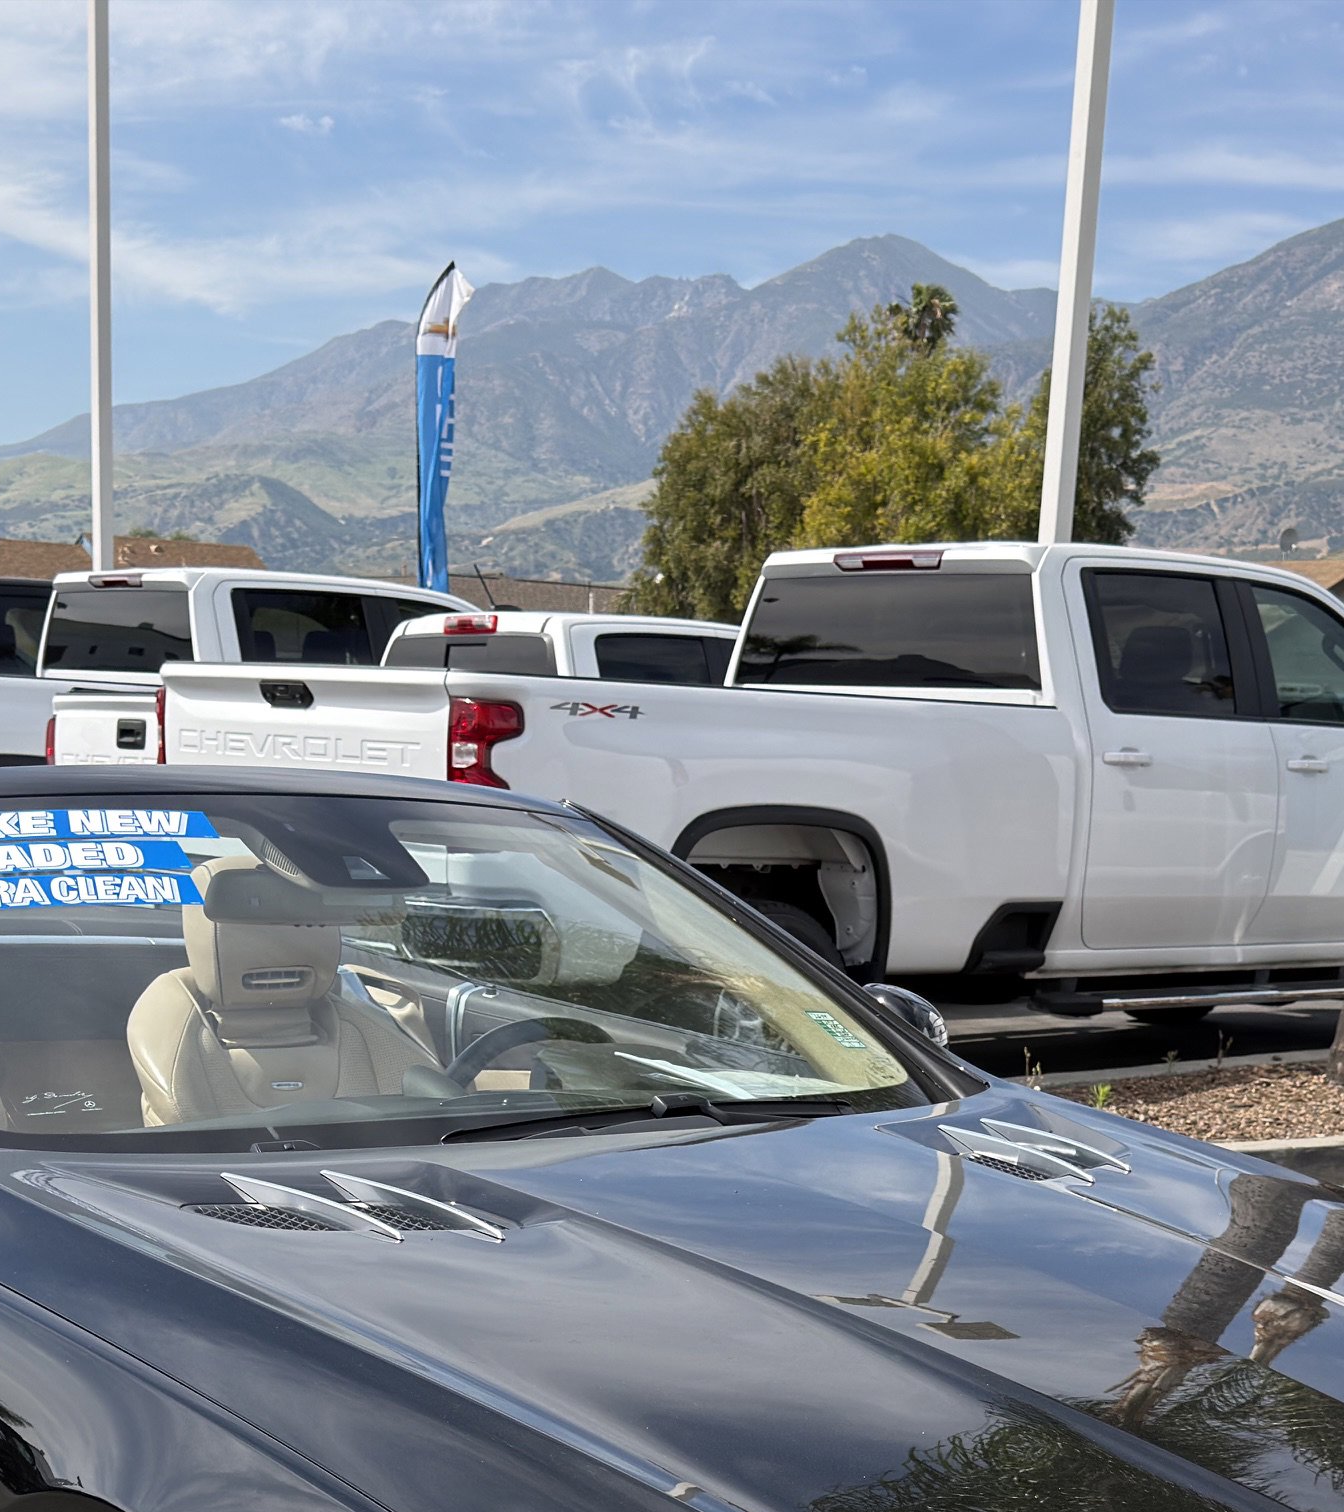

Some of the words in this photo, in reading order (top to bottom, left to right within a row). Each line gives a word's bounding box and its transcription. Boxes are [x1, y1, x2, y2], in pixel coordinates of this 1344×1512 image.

[179, 728, 422, 767] CHEVROLET
[67, 809, 188, 836] NEW
[50, 875, 182, 906] CLEAN
